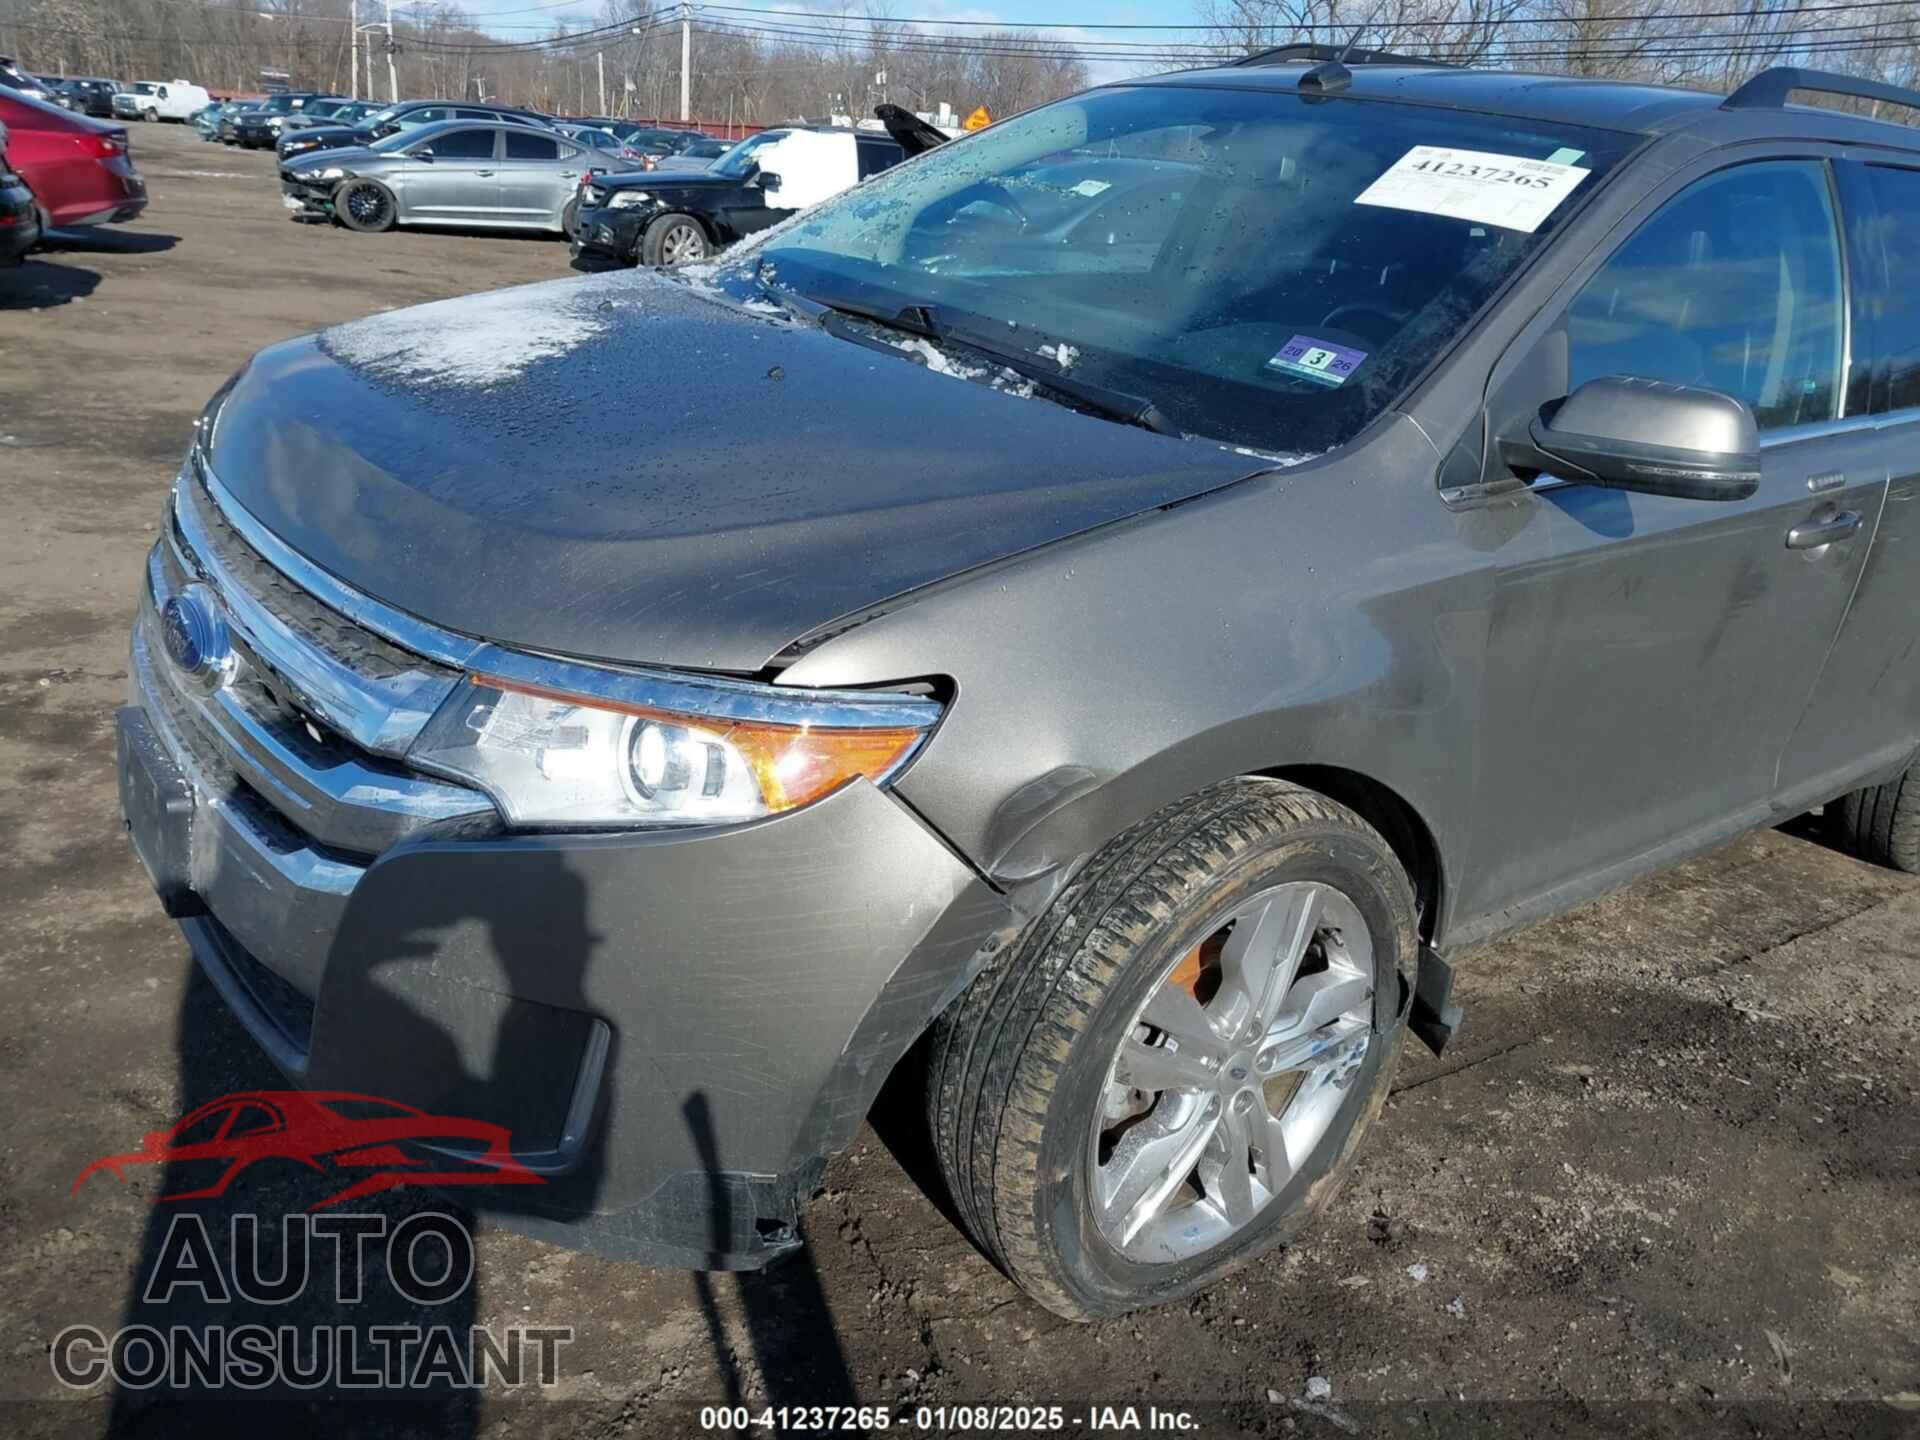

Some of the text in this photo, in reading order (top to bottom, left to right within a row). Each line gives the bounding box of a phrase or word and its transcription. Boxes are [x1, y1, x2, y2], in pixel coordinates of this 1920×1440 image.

[1410, 160, 1556, 190] 41237265
[1310, 351, 1327, 366] 3
[1331, 359, 1353, 371] 26
